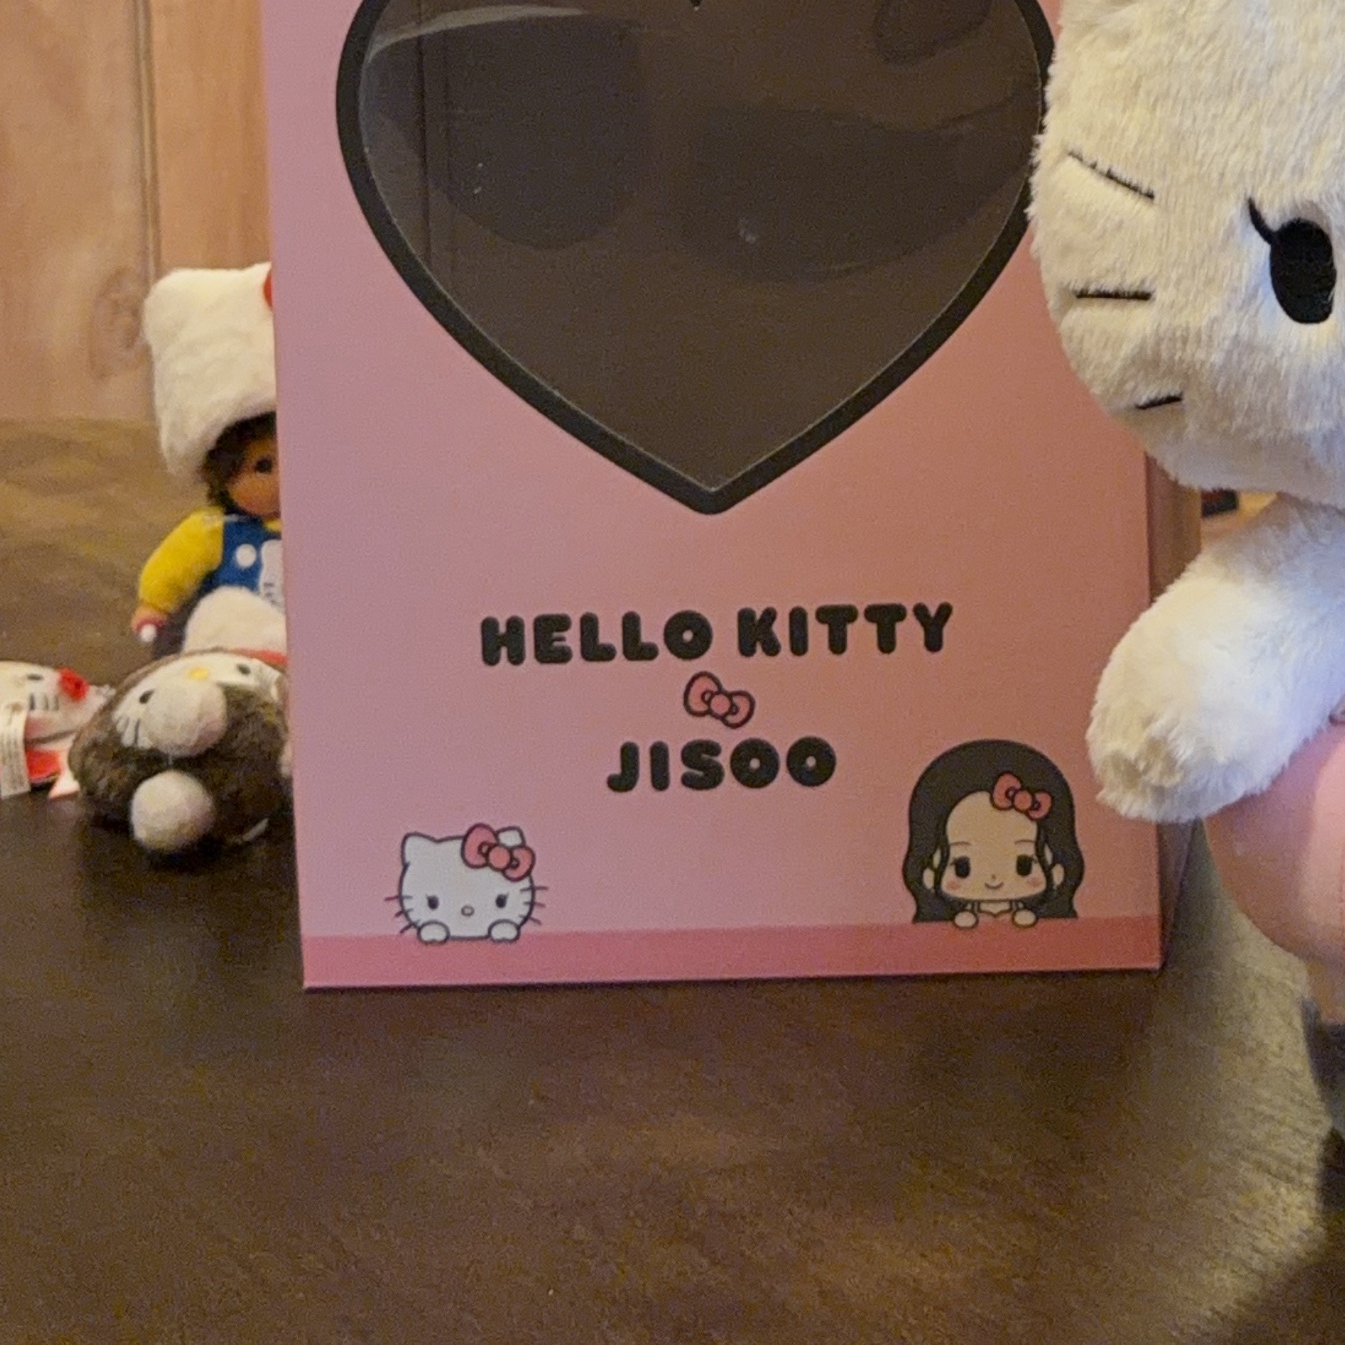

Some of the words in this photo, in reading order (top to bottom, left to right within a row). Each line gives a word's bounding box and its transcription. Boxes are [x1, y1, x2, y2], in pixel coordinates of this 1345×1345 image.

[480, 609, 714, 667] HELLO
[737, 601, 954, 658] KITTY
[606, 735, 838, 793] JISOO
